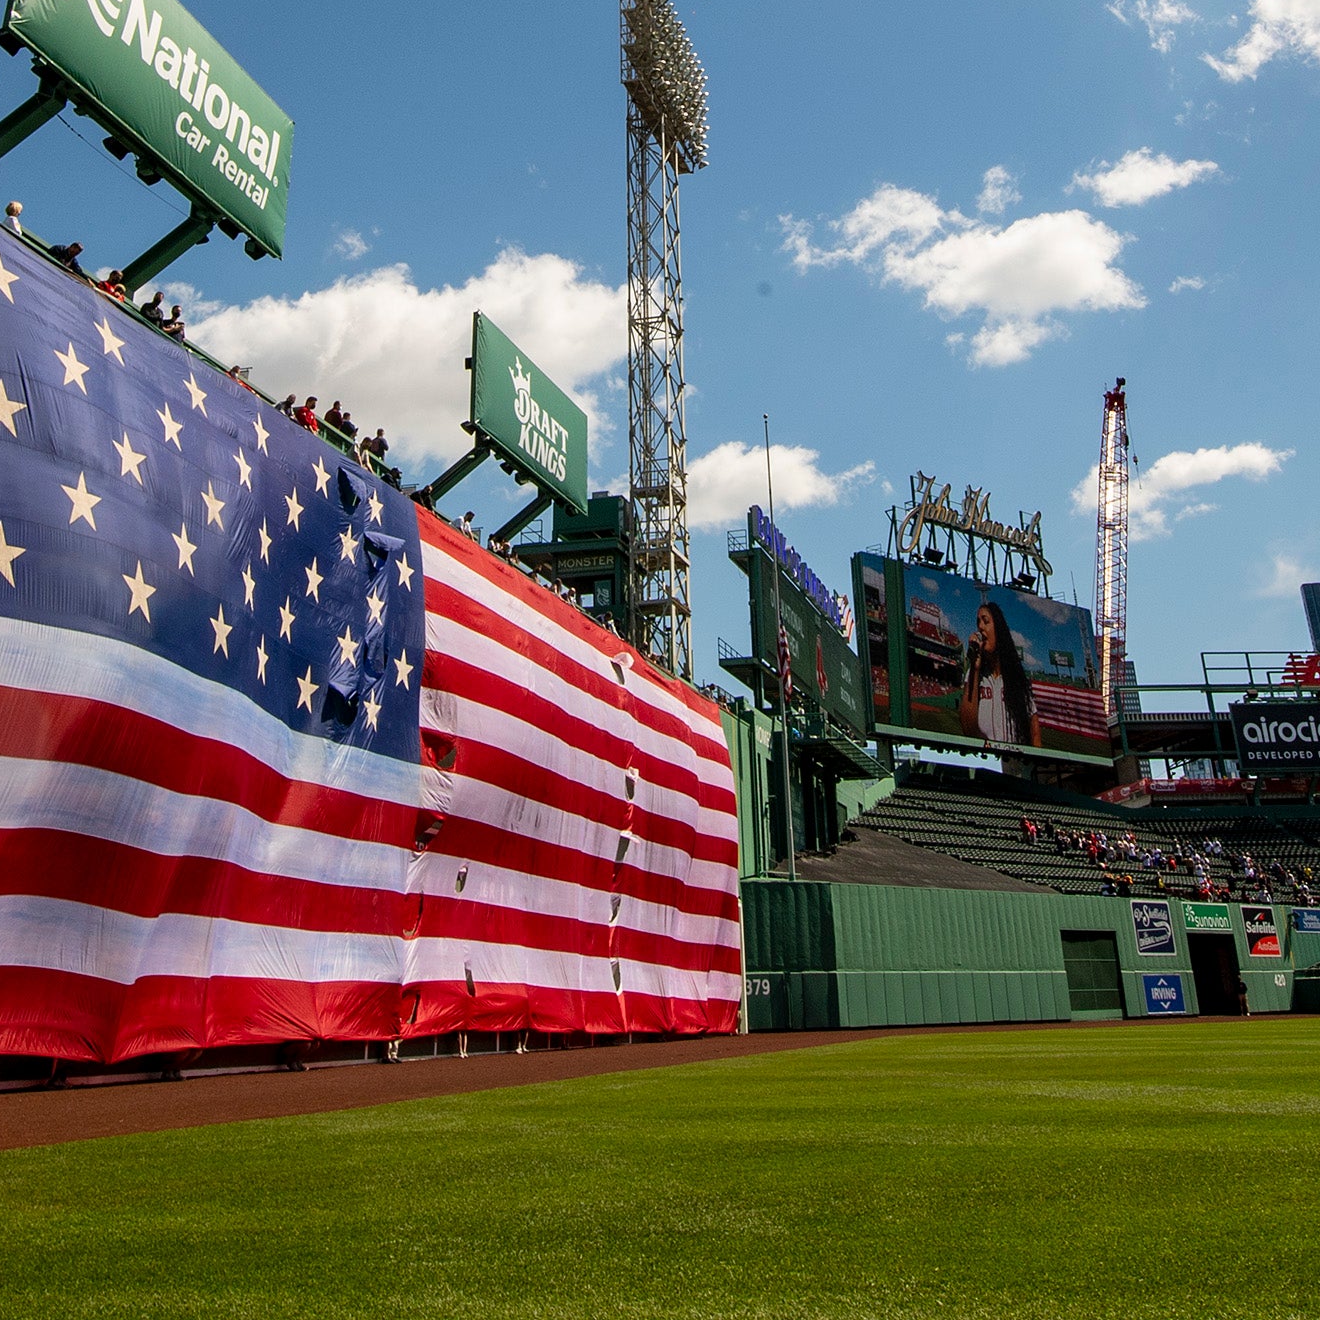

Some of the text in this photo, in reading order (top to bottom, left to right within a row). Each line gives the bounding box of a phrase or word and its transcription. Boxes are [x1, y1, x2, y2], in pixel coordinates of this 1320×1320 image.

[175, 112, 270, 210] Car Rental
[514, 387, 569, 454] DRAFT
[518, 423, 567, 482] KINGS
[897, 470, 959, 553] John
[557, 555, 614, 568] MONSTER
[1248, 750, 1313, 759] DEVELOPED
[1195, 913, 1229, 928] sunovion
[1246, 920, 1276, 934] Safelite
[746, 978, 771, 996] 379
[1151, 987, 1177, 1000] IRVING
